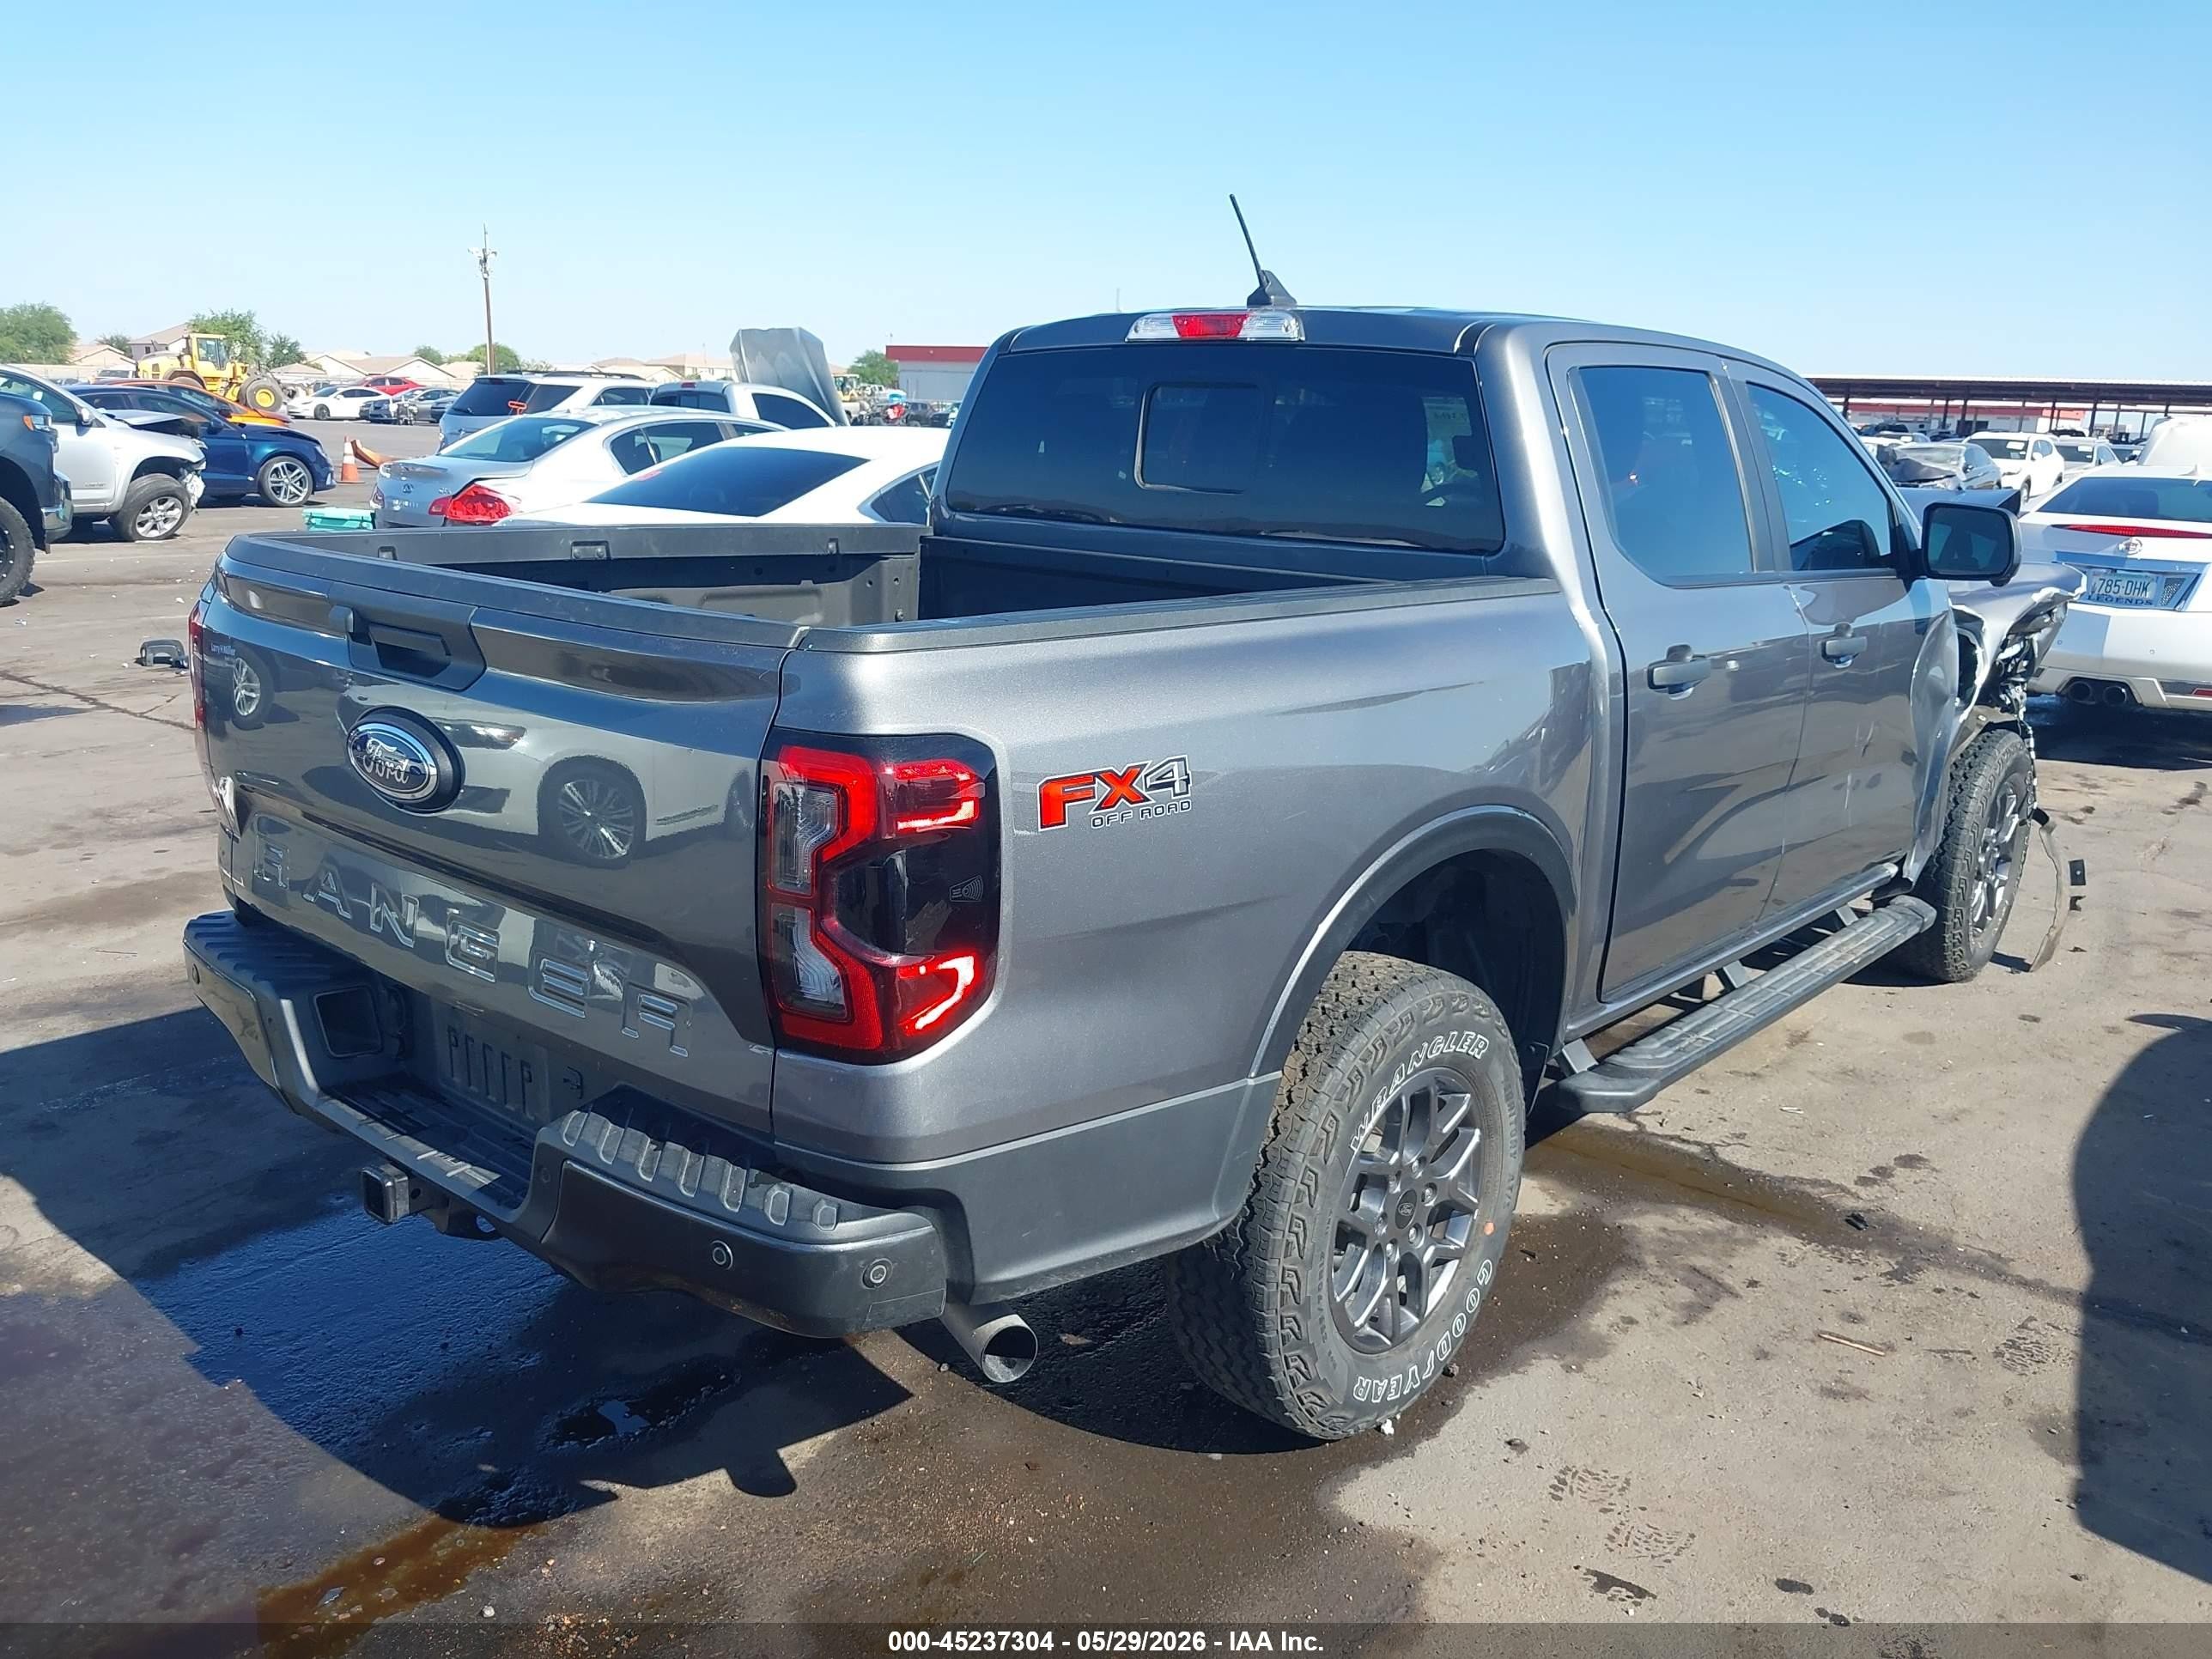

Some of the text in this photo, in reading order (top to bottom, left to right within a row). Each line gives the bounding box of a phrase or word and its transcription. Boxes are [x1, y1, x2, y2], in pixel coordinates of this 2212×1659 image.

[2087, 594, 2153, 606] LEGENDS
[363, 738, 410, 784] Ford
[1036, 755, 1193, 832] FX4
[1091, 799, 1192, 829] OFF ROAD
[254, 831, 693, 1058] RANGER
[1350, 1030, 1490, 1152] WRANGLER
[1352, 1259, 1493, 1403] GOODYEAR
